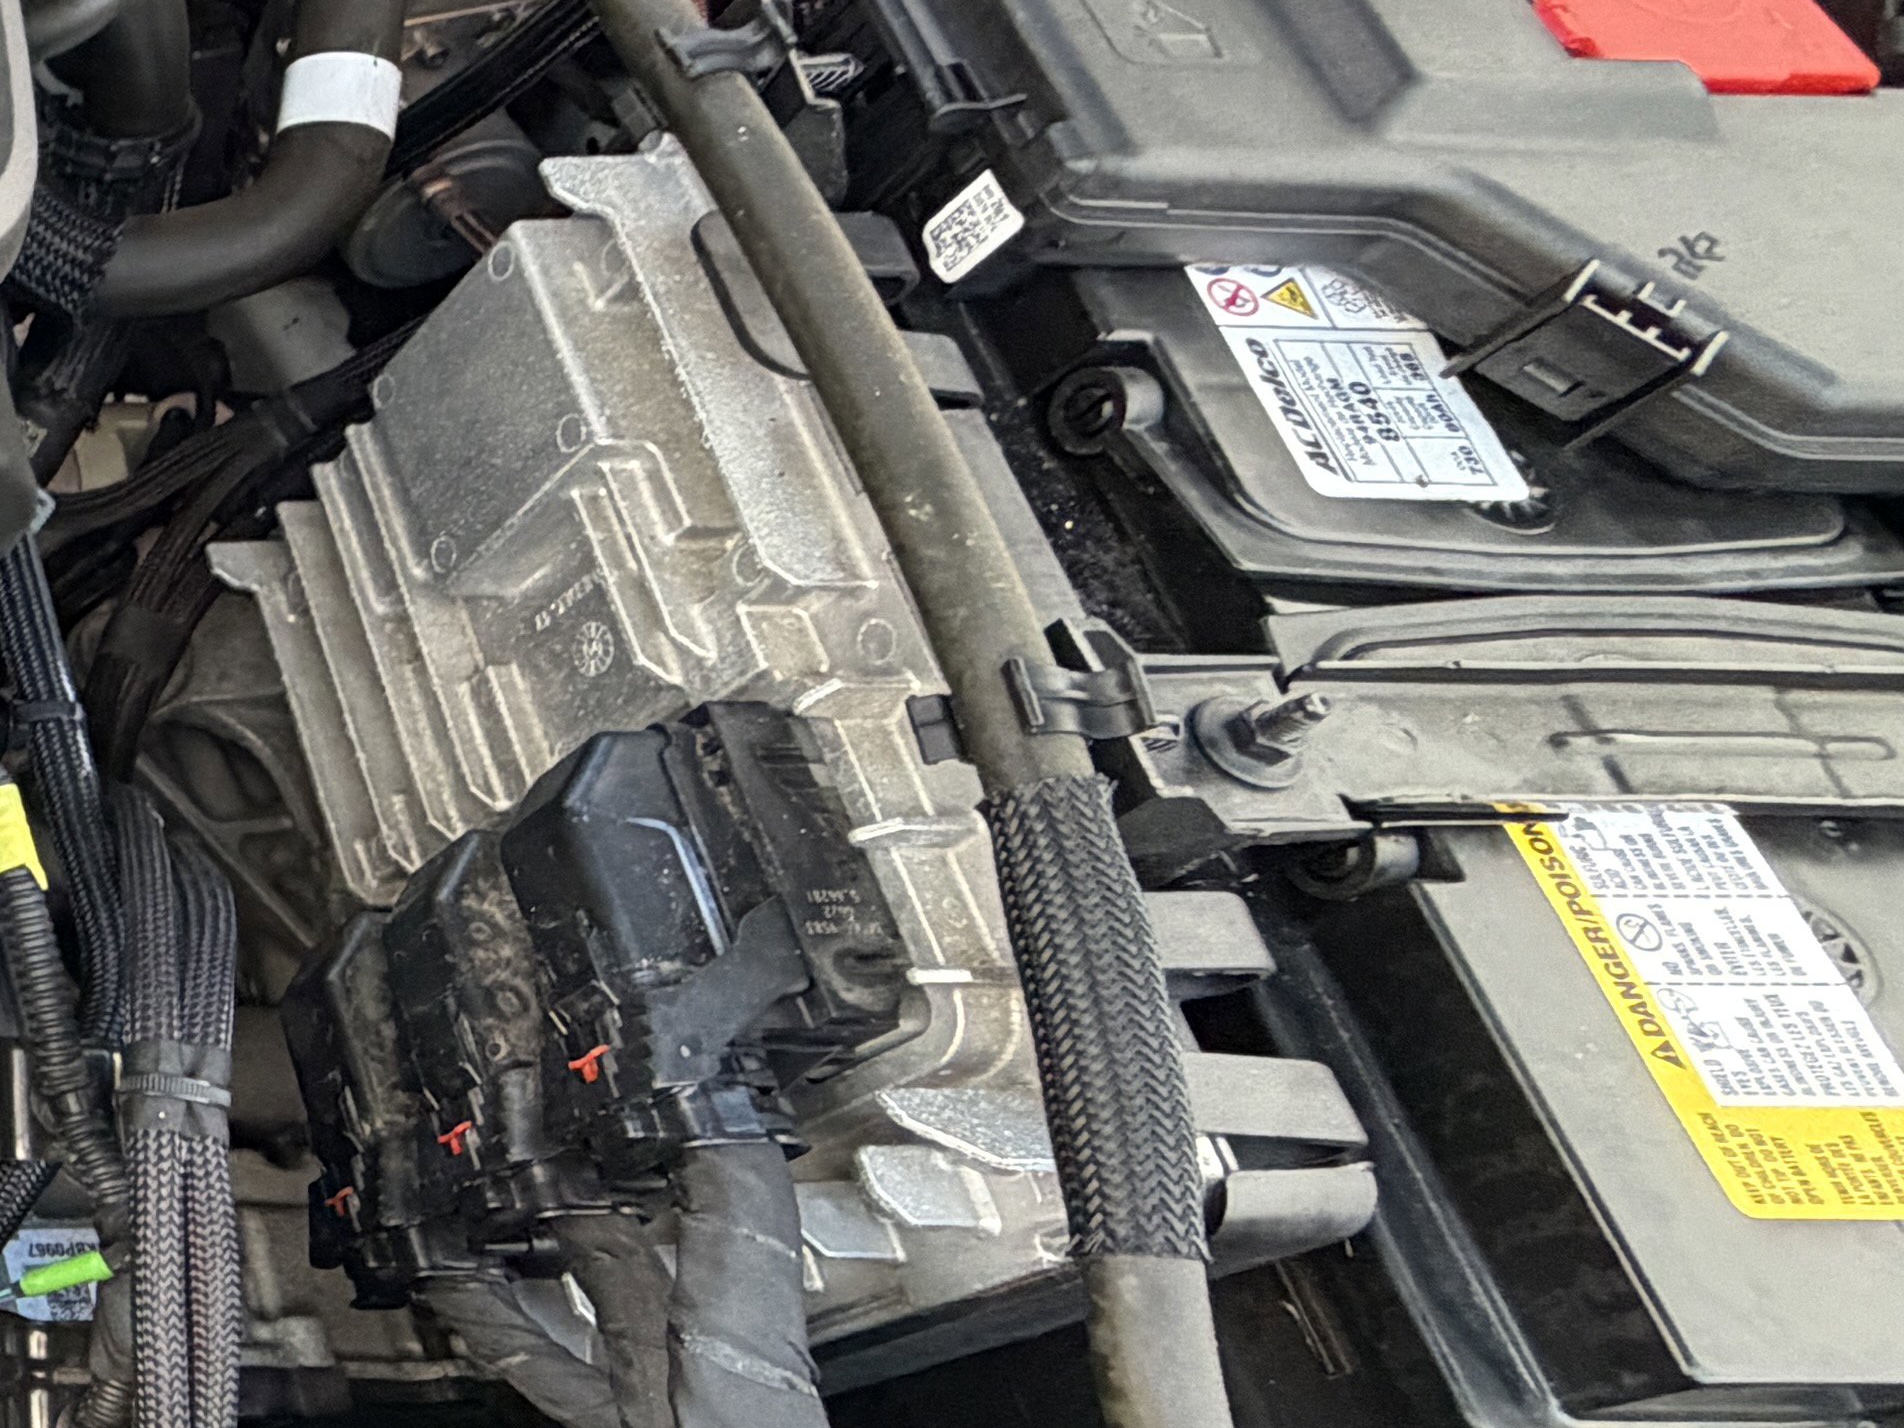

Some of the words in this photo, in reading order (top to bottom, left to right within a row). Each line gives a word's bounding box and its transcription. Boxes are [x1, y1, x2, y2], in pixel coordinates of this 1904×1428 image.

[1246, 338, 1339, 475] ACDelco
[1347, 382, 1400, 441] 8540
[1457, 446, 1483, 474] 730
[1521, 821, 1667, 1036] DANGER/POISON
[1719, 1147, 1736, 1156] OF
[1728, 1161, 1749, 1177] OUT
